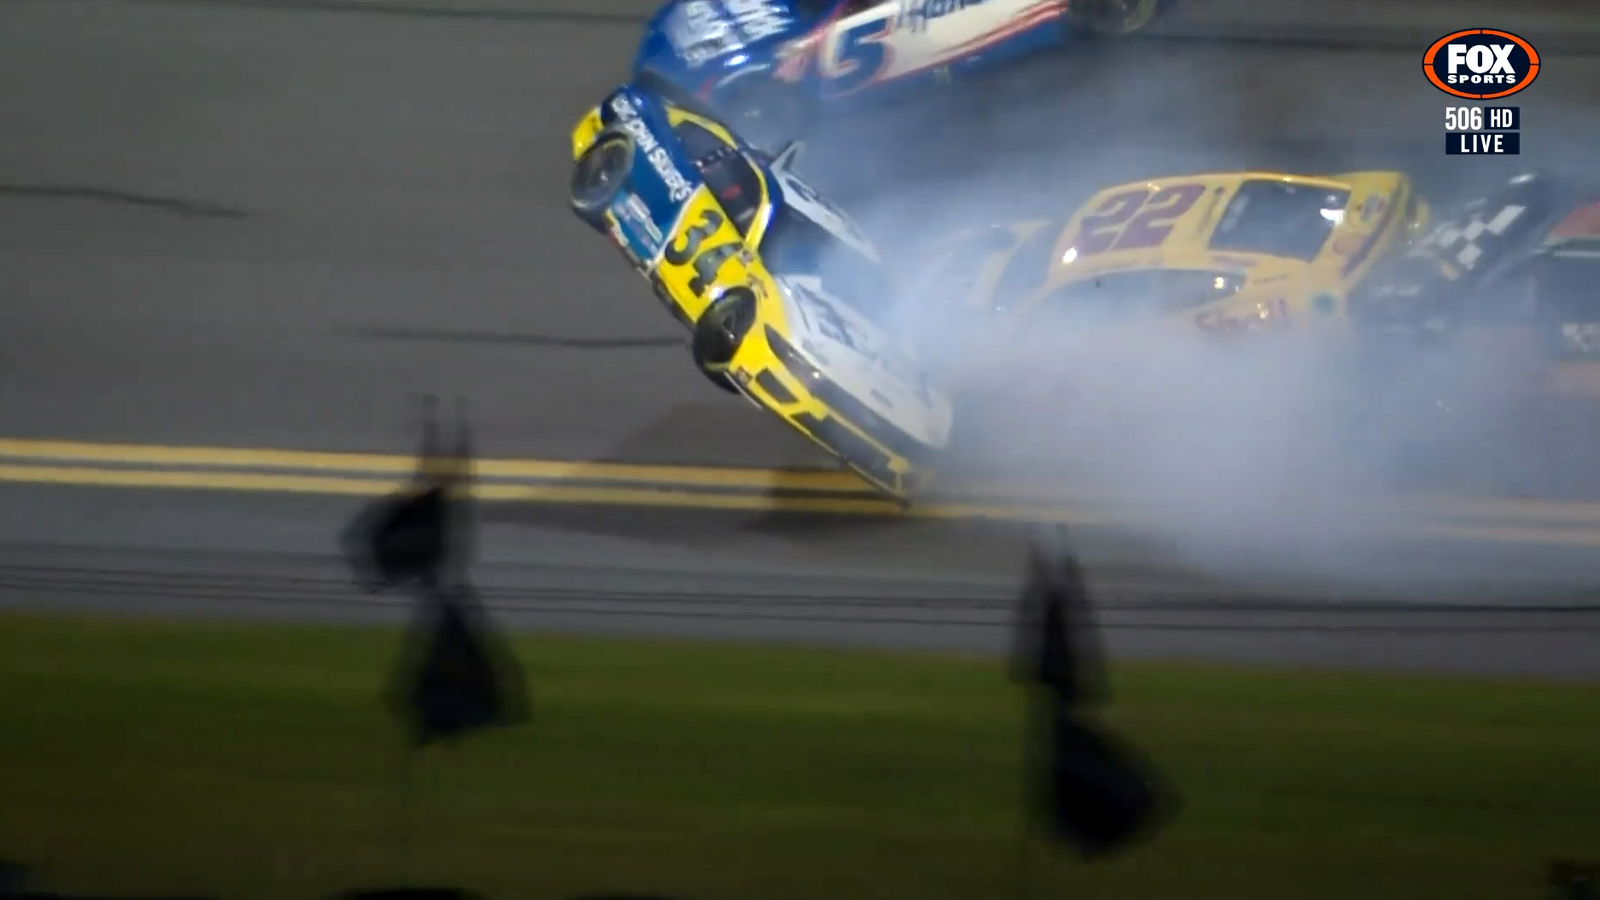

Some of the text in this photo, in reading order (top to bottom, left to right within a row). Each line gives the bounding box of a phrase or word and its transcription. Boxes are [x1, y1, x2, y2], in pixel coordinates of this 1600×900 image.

[820, 16, 893, 97] 5
[664, 208, 743, 298] 34
[1072, 184, 1206, 256] 22
